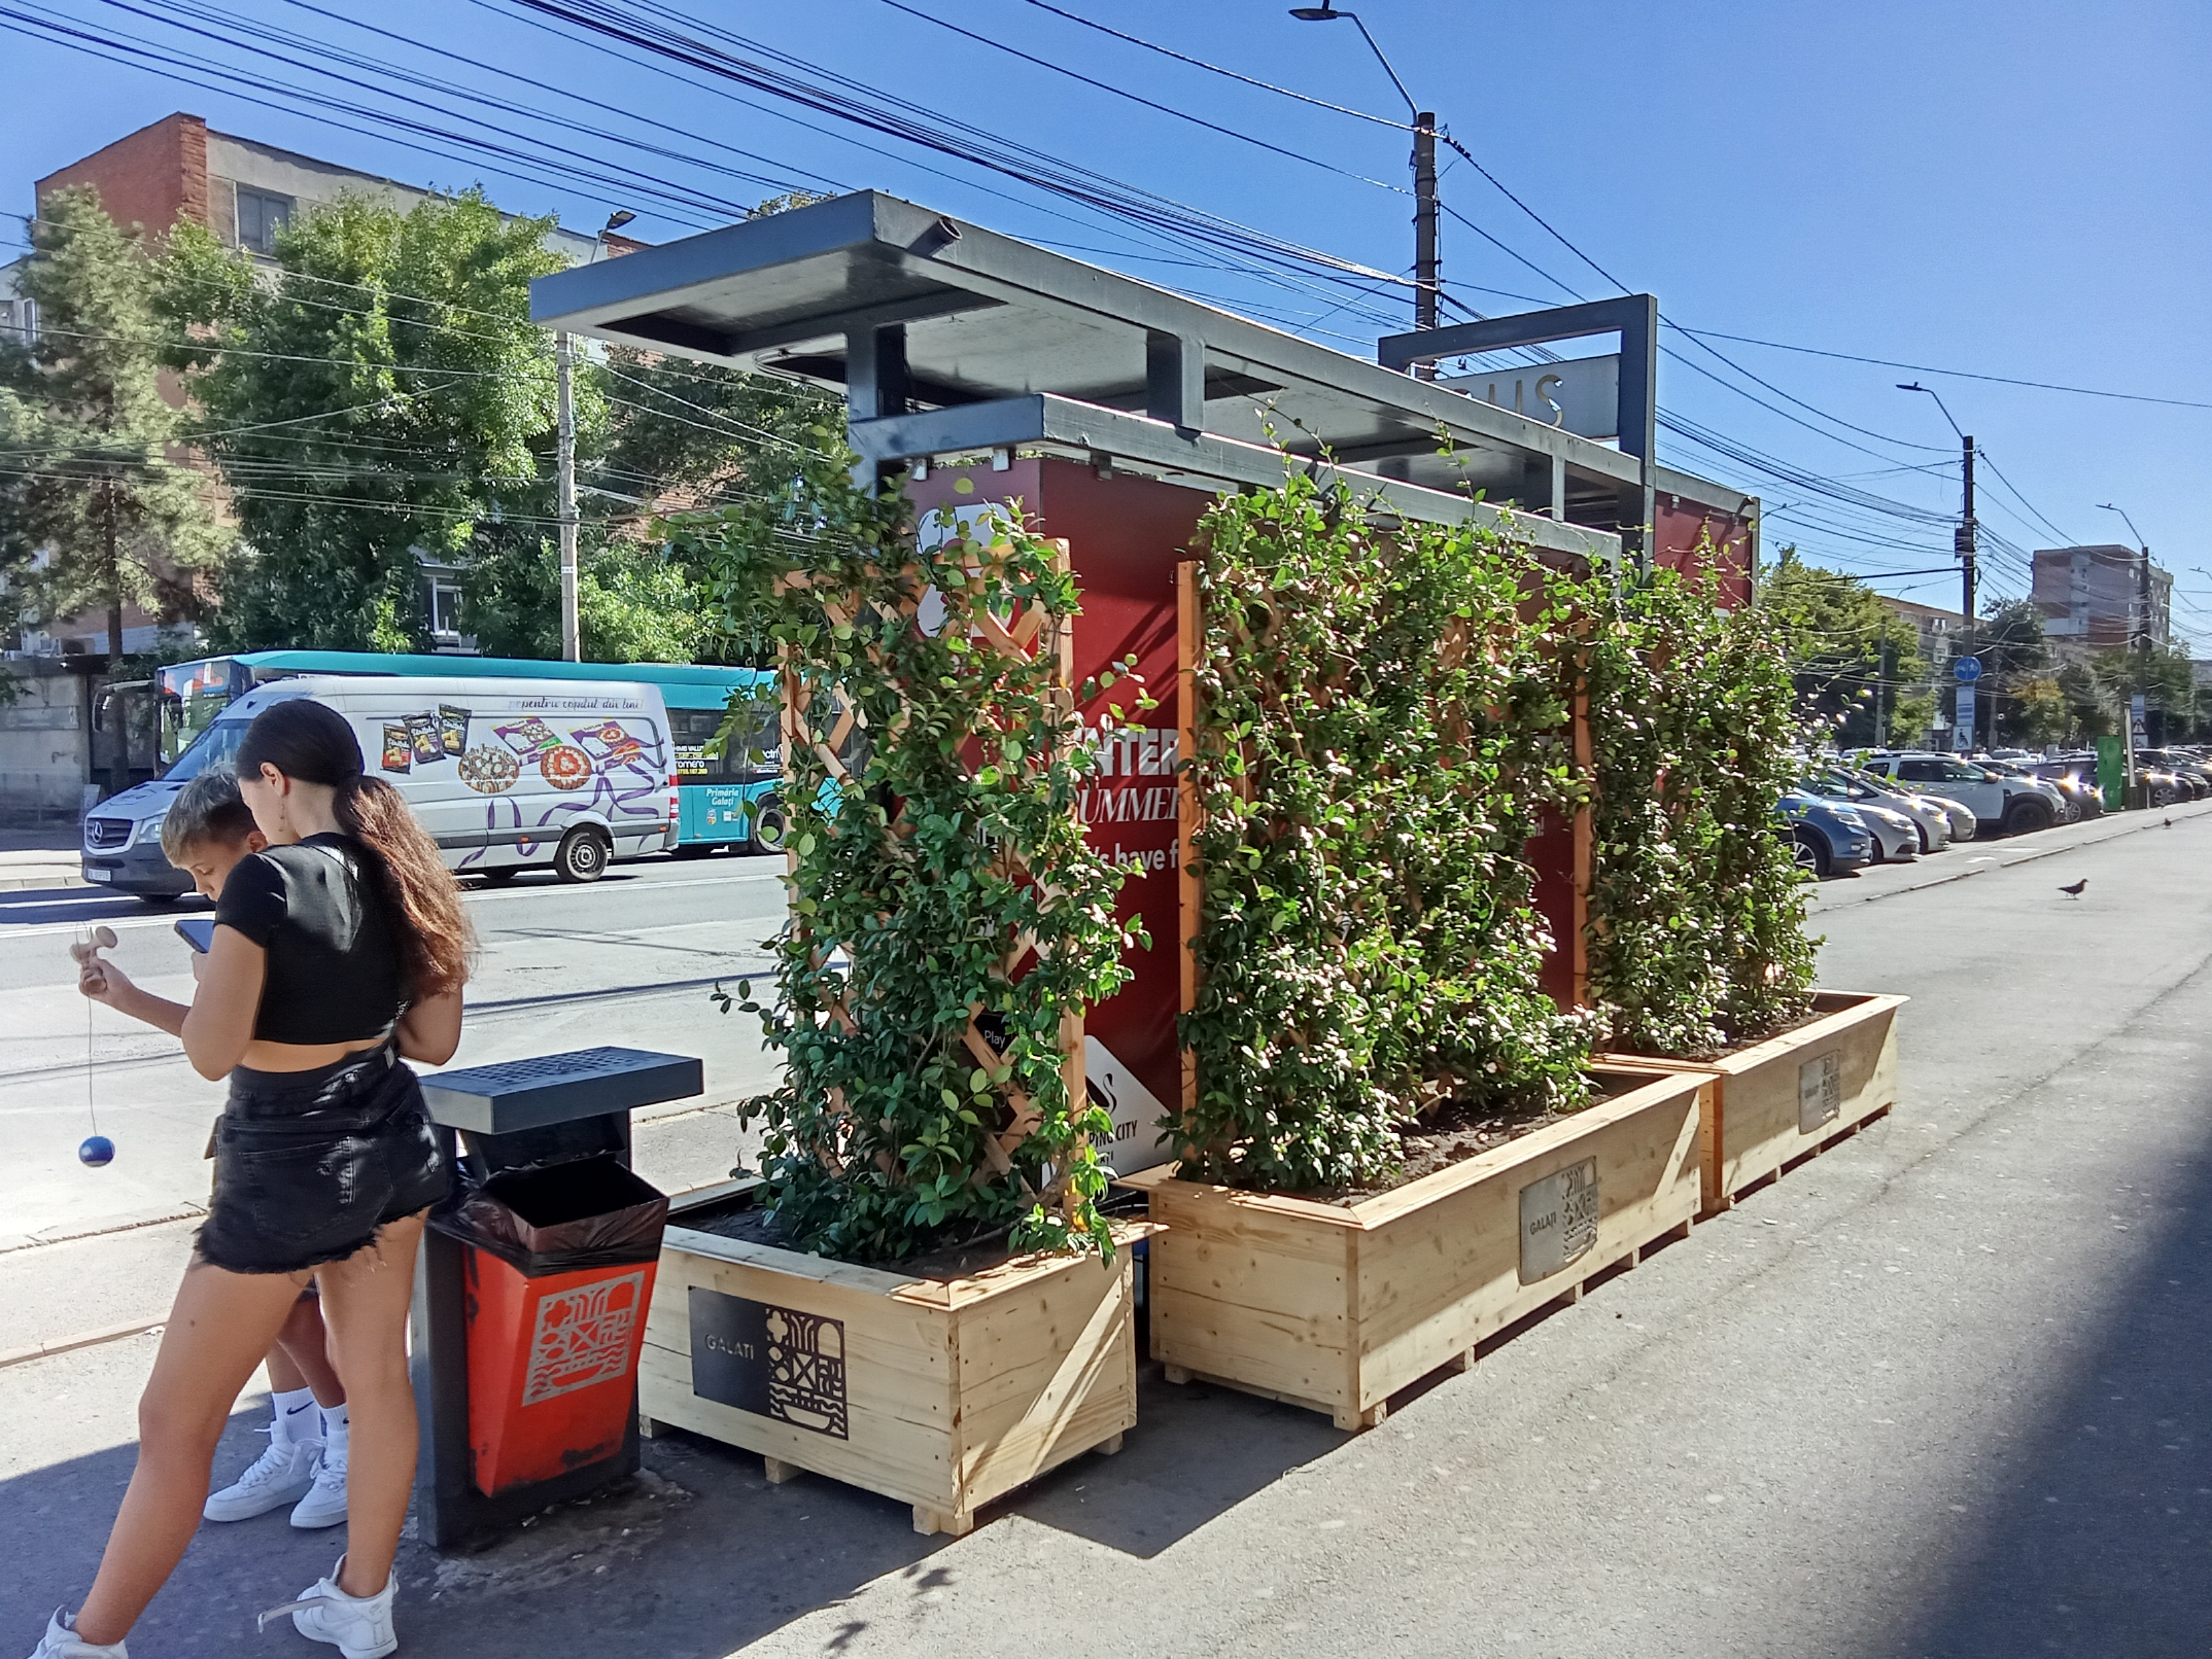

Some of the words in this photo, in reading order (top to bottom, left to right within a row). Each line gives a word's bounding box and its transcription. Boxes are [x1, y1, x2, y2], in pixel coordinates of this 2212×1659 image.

[1076, 787, 1180, 824] UMME
[1115, 842, 1165, 870] have
[984, 1029, 1006, 1049] Play
[1116, 1119, 1138, 1141] CITY
